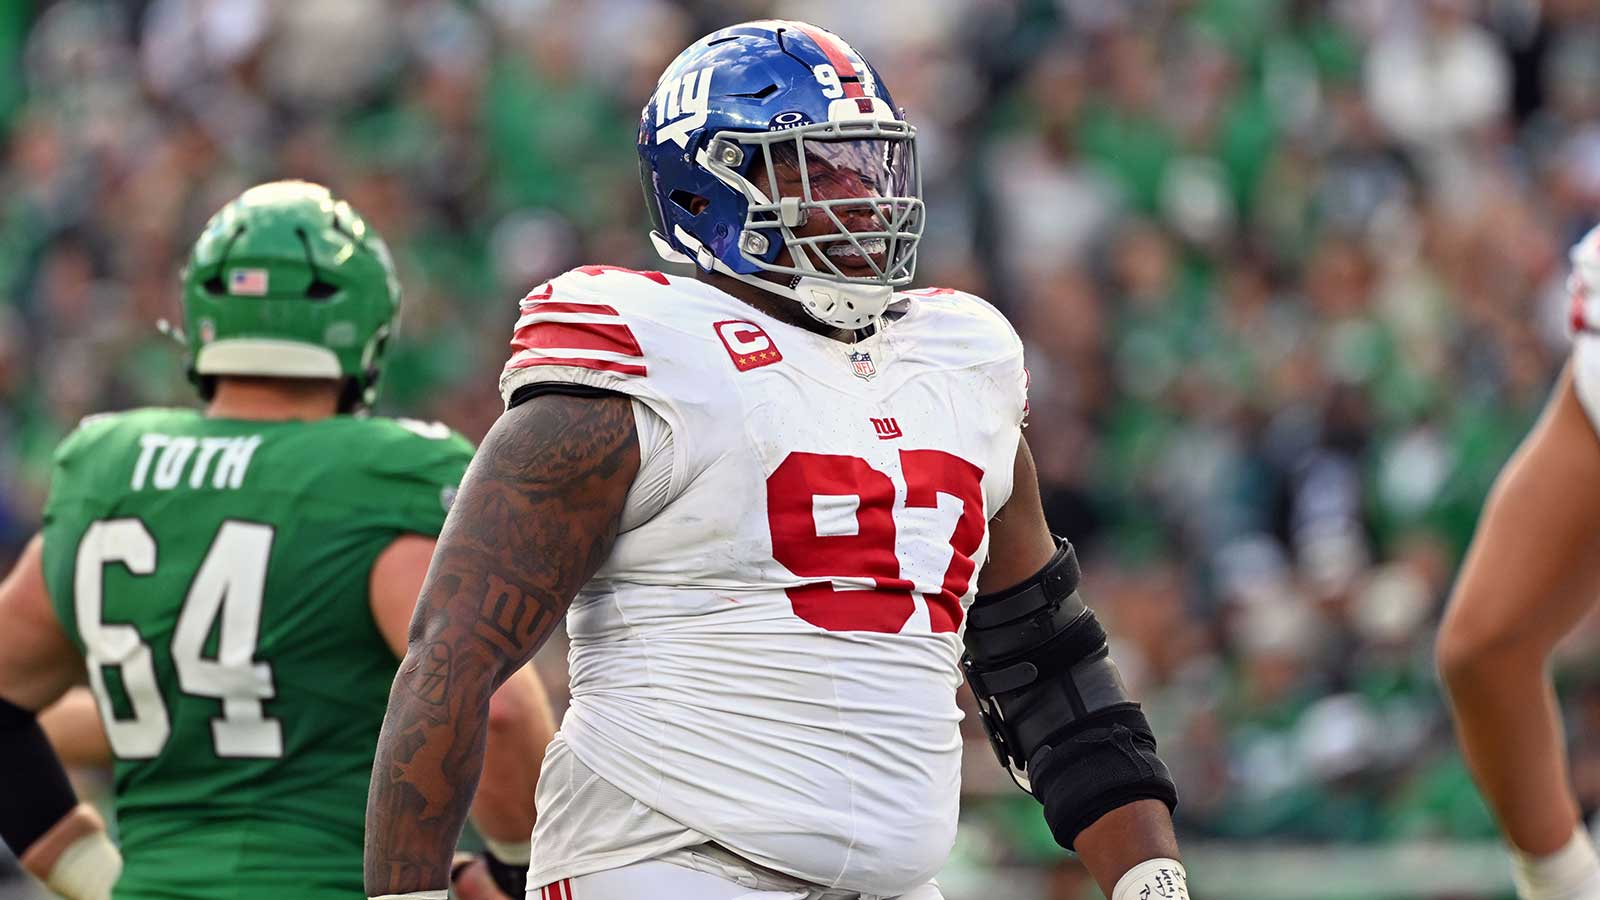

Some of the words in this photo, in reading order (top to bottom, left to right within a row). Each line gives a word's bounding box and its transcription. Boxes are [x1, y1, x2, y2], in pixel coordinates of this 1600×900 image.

[770, 121, 811, 132] OAKLEY
[720, 322, 770, 354] C
[854, 361, 874, 375] NFL
[130, 433, 262, 491] TOTH
[766, 448, 985, 633] 97
[74, 518, 284, 759] 64
